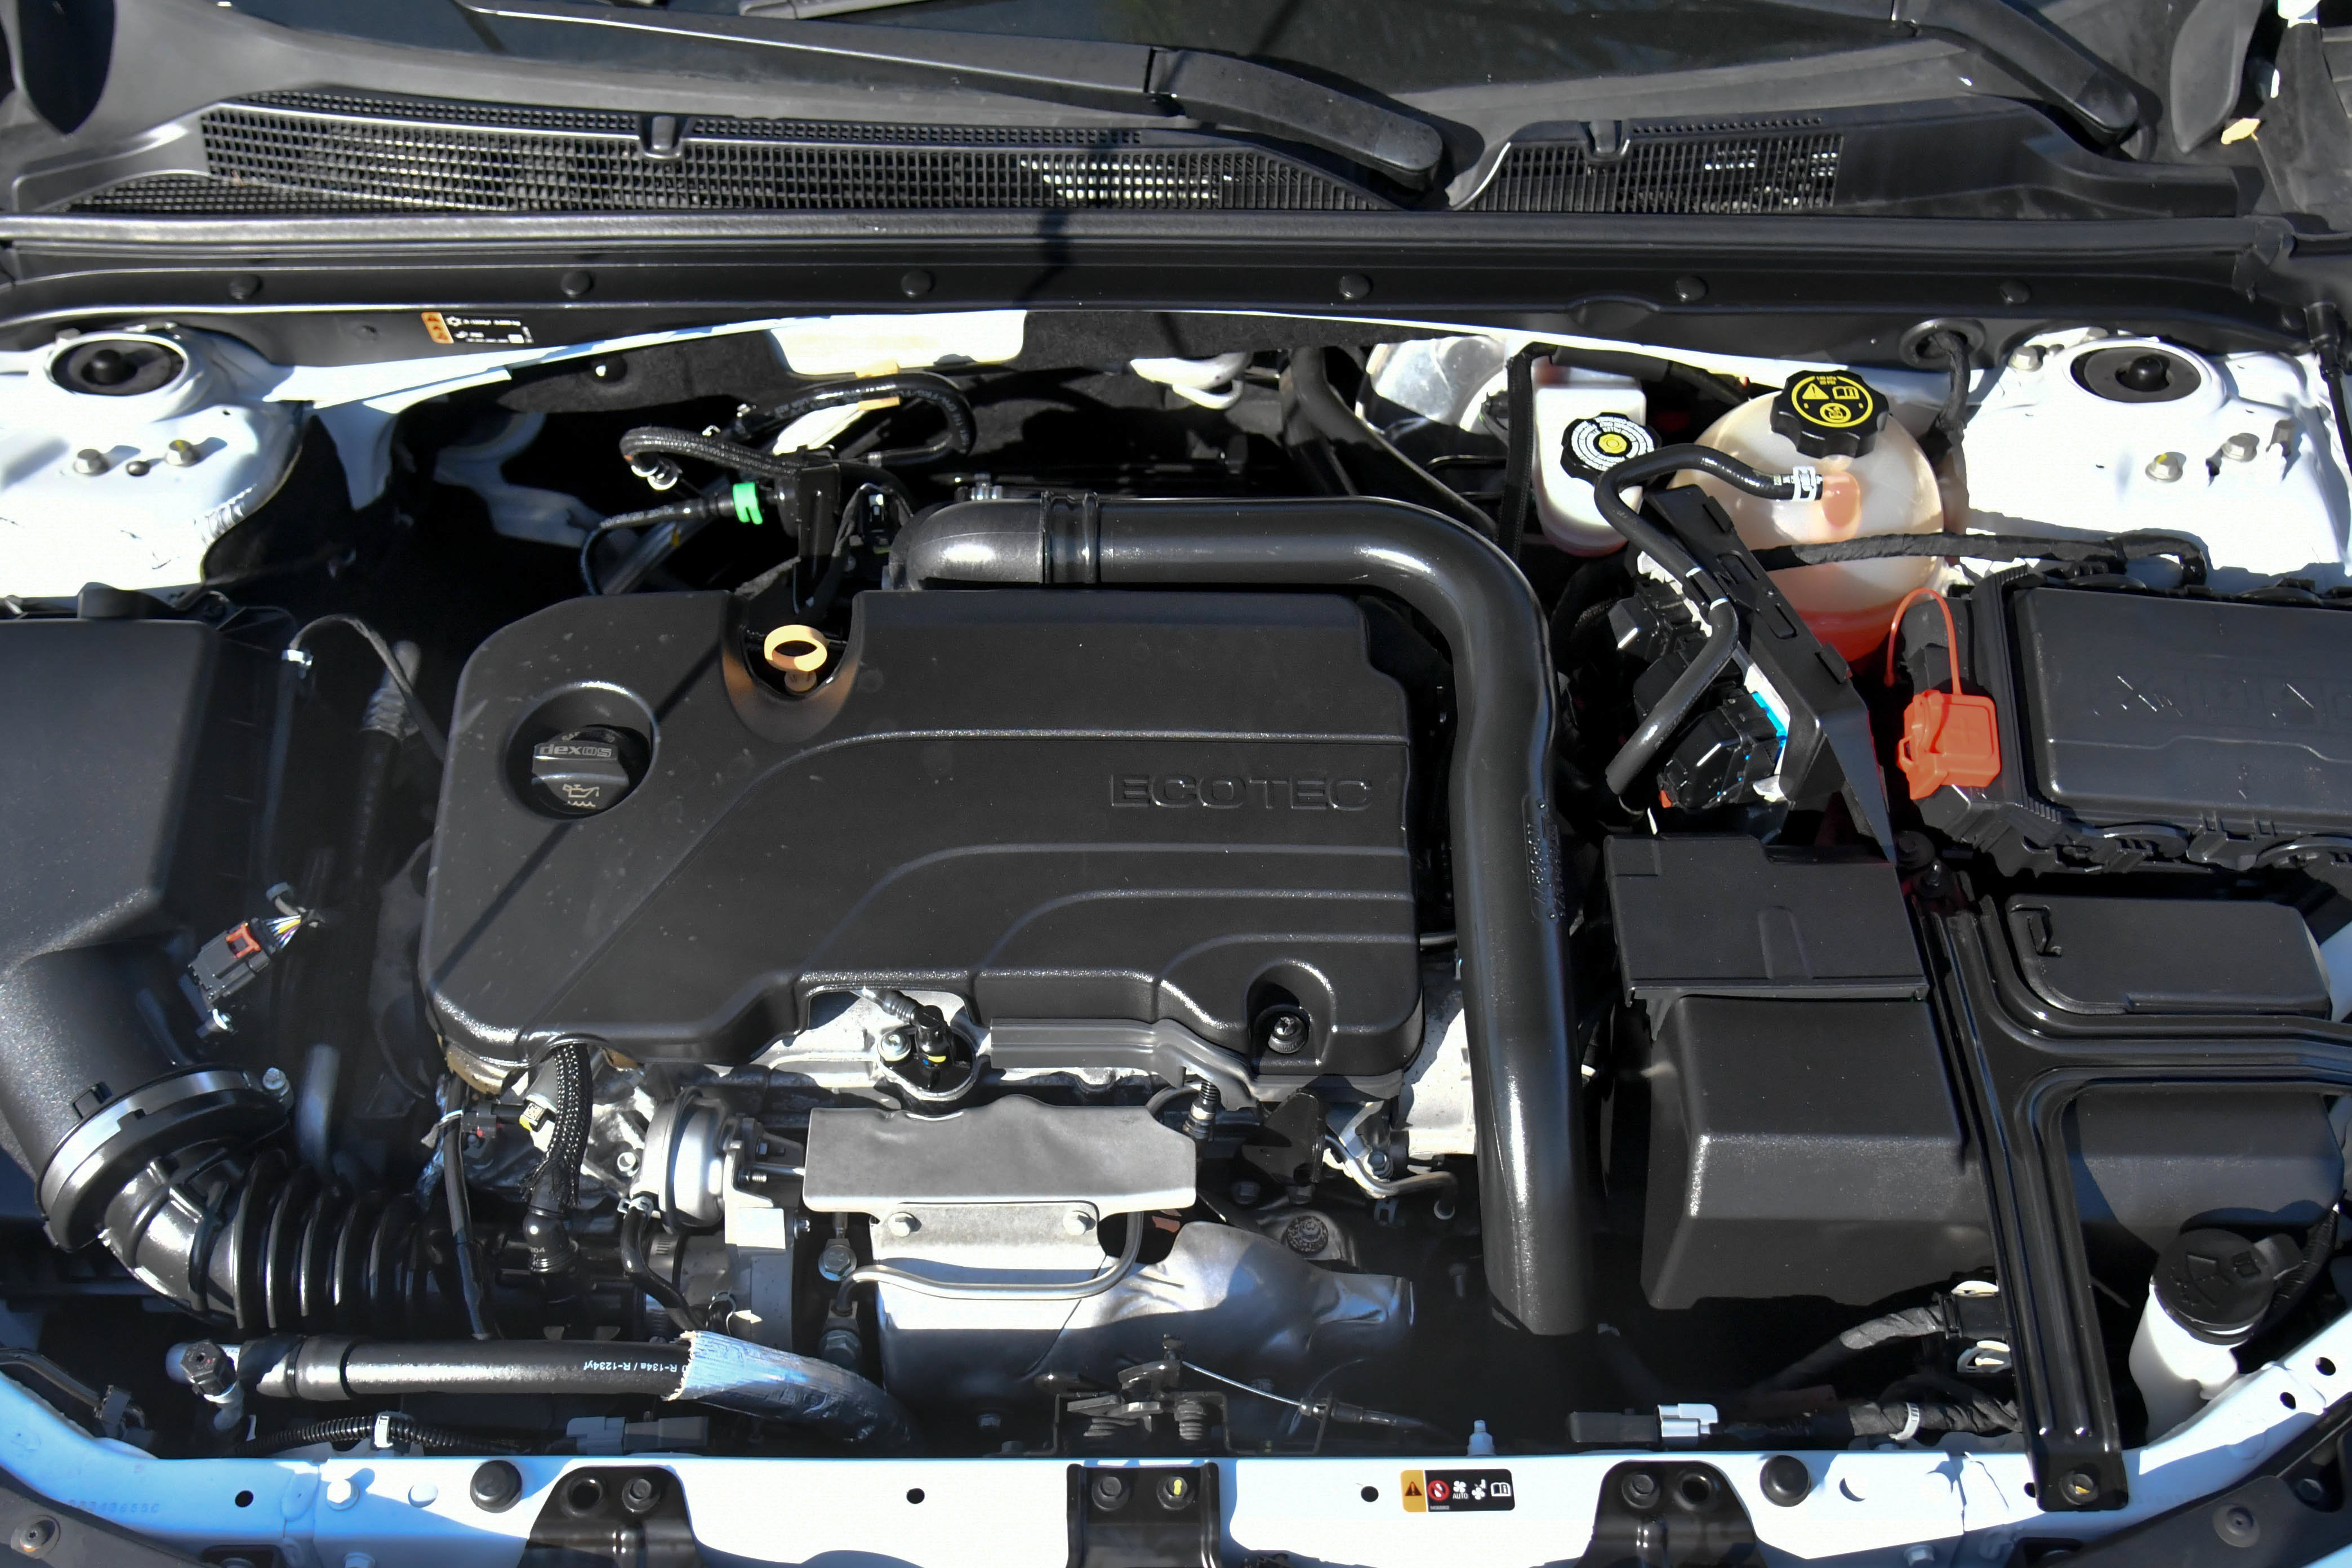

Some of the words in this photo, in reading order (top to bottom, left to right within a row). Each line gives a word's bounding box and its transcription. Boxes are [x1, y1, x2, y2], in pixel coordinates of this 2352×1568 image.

[540, 743, 612, 758] dexos
[1110, 774, 1373, 811] ECOTEC
[583, 1360, 631, 1371] R-1234yf
[640, 1362, 678, 1373] R-134a
